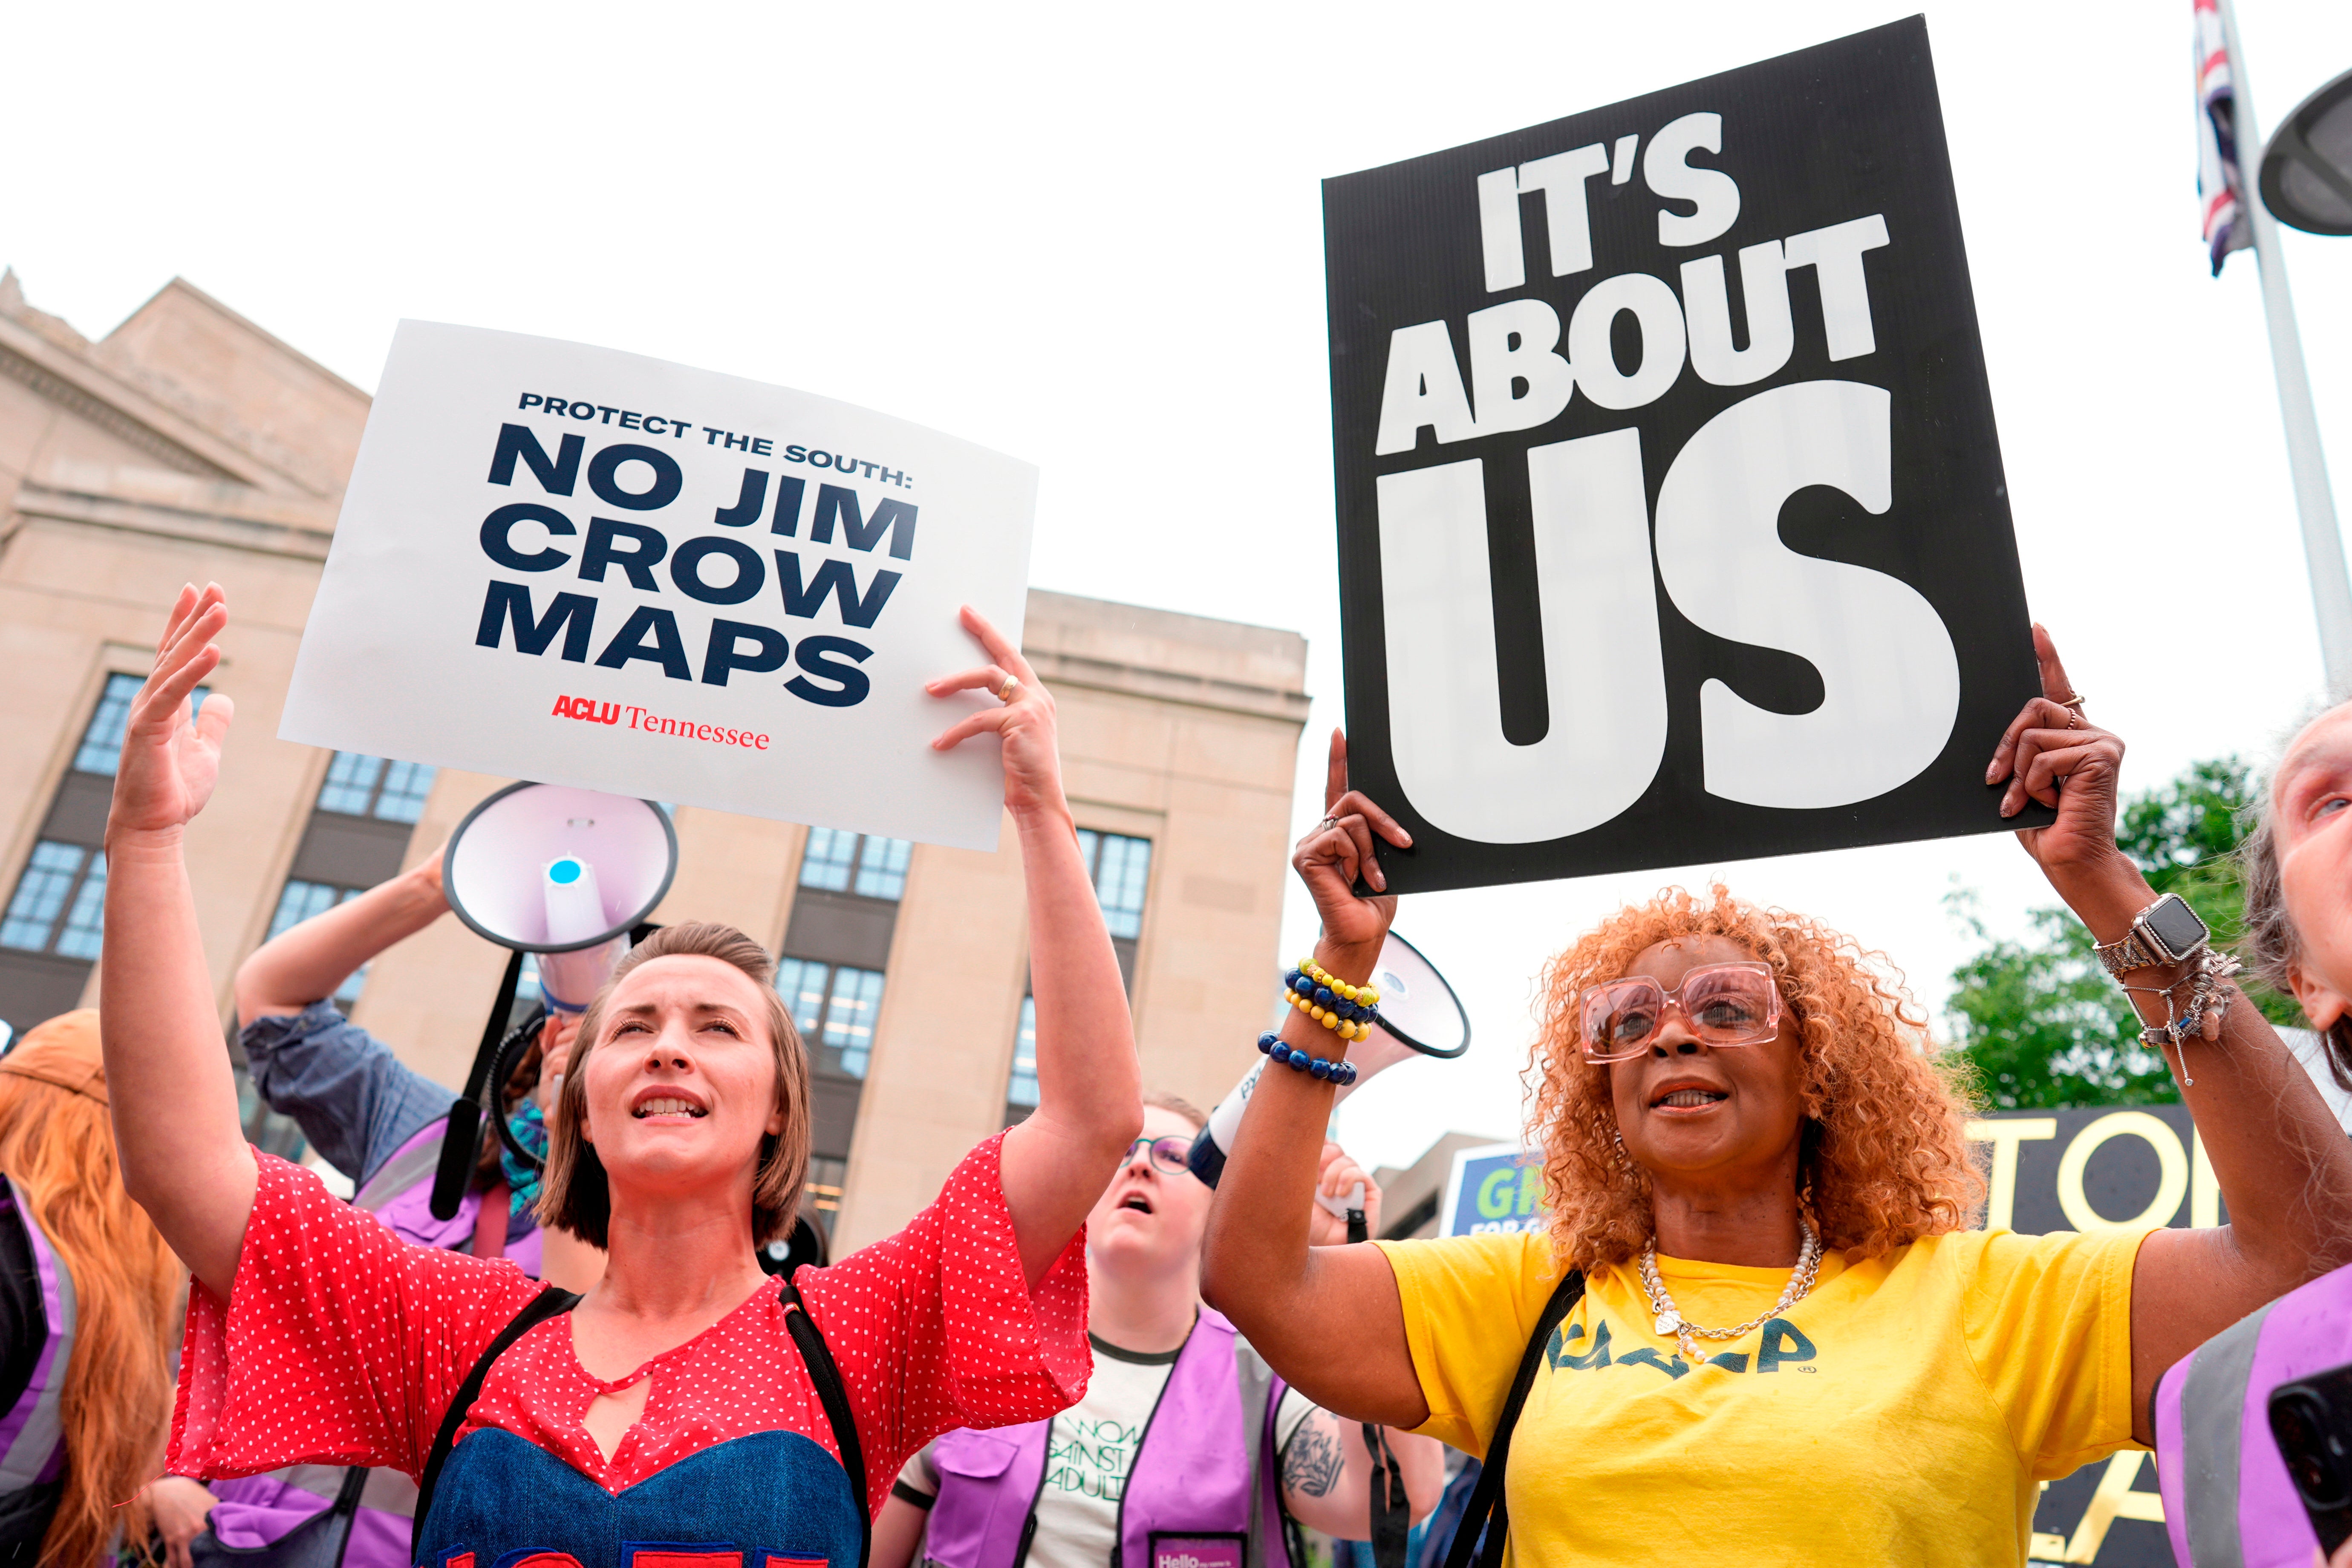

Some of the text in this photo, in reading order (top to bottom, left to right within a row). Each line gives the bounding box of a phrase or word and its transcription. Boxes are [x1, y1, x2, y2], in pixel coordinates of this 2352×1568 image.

[1477, 112, 1740, 293] IT'S
[1375, 214, 1890, 456] ABOUT
[487, 423, 918, 561] NO JIM
[519, 393, 912, 489] PROTECT THE SOUTH:
[479, 503, 903, 629] CROW
[1376, 380, 1960, 844] US
[475, 580, 874, 707] MAPS
[551, 695, 770, 751] ACLU Tennessee
